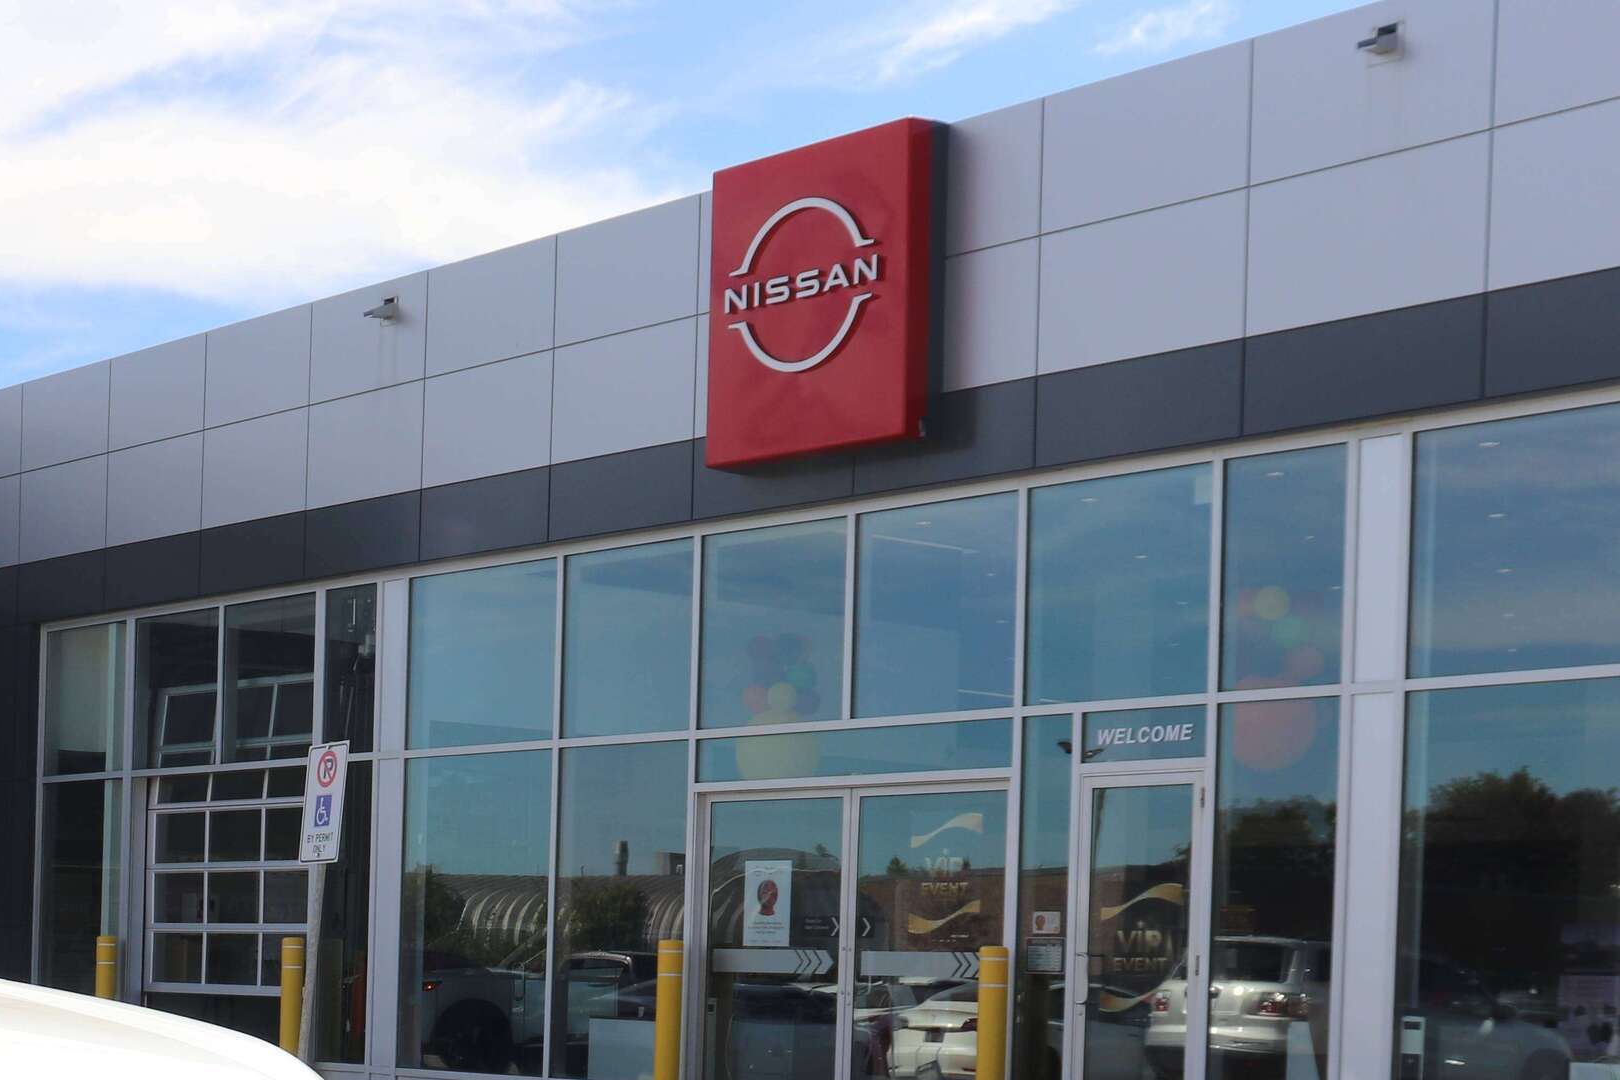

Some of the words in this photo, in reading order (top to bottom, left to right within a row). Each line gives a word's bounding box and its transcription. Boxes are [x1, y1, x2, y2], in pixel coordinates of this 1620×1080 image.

[723, 253, 880, 315] NISSAN
[1097, 723, 1194, 746] WELCOME
[315, 832, 333, 843] PERMIT
[920, 881, 969, 896] EVENT
[1113, 957, 1168, 972] EVENT
